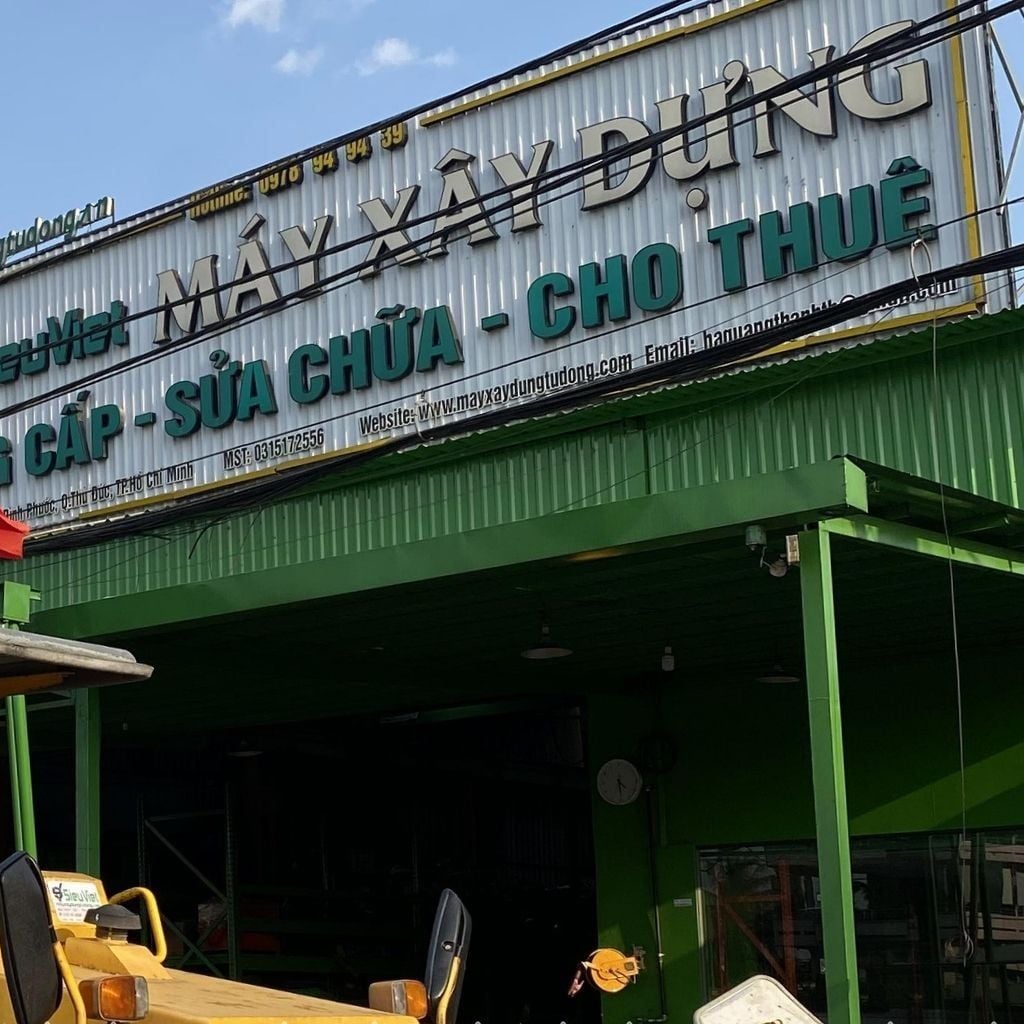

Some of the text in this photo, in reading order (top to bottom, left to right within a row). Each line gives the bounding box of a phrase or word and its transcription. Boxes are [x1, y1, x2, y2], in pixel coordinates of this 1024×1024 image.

[153, 20, 934, 345] MÁY XÂY DỰNG
[312, 150, 337, 176] 94
[346, 137, 373, 162] 94
[380, 122, 406, 150] 39
[25, 390, 124, 477] CẤP
[164, 349, 278, 438] SỬA
[288, 304, 464, 404] CHỮA
[527, 242, 683, 340] CHO
[707, 156, 938, 293] THUÊ
[359, 408, 415, 437] Website:
[416, 351, 633, 423] www.mayxaydungtudong.com
[645, 337, 696, 366] Email:
[167, 461, 194, 484] Minh
[224, 429, 324, 471] MST: 0315172556
